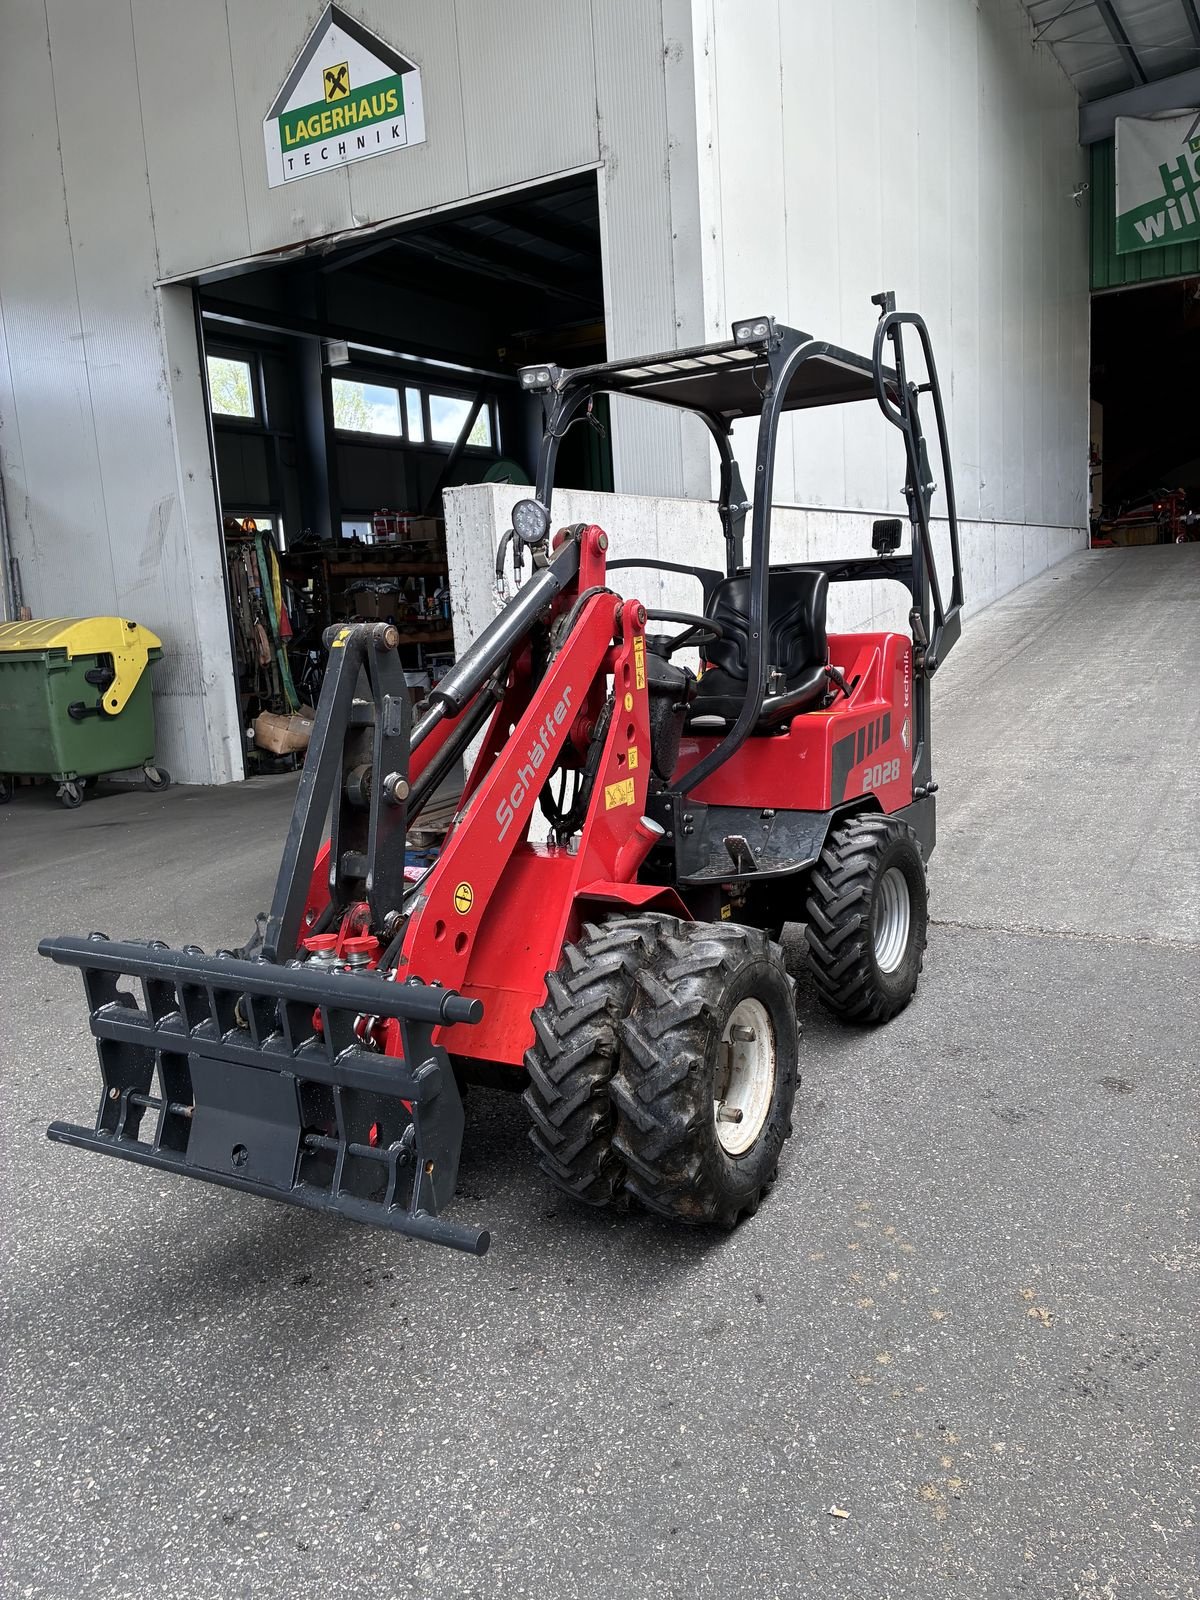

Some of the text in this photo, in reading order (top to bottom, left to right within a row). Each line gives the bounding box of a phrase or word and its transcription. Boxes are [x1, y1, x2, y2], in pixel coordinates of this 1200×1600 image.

[284, 89, 398, 146] LAGERHAUS
[288, 125, 400, 171] TECHNIK
[495, 685, 572, 842] Schäffer
[862, 757, 901, 793] 2028
